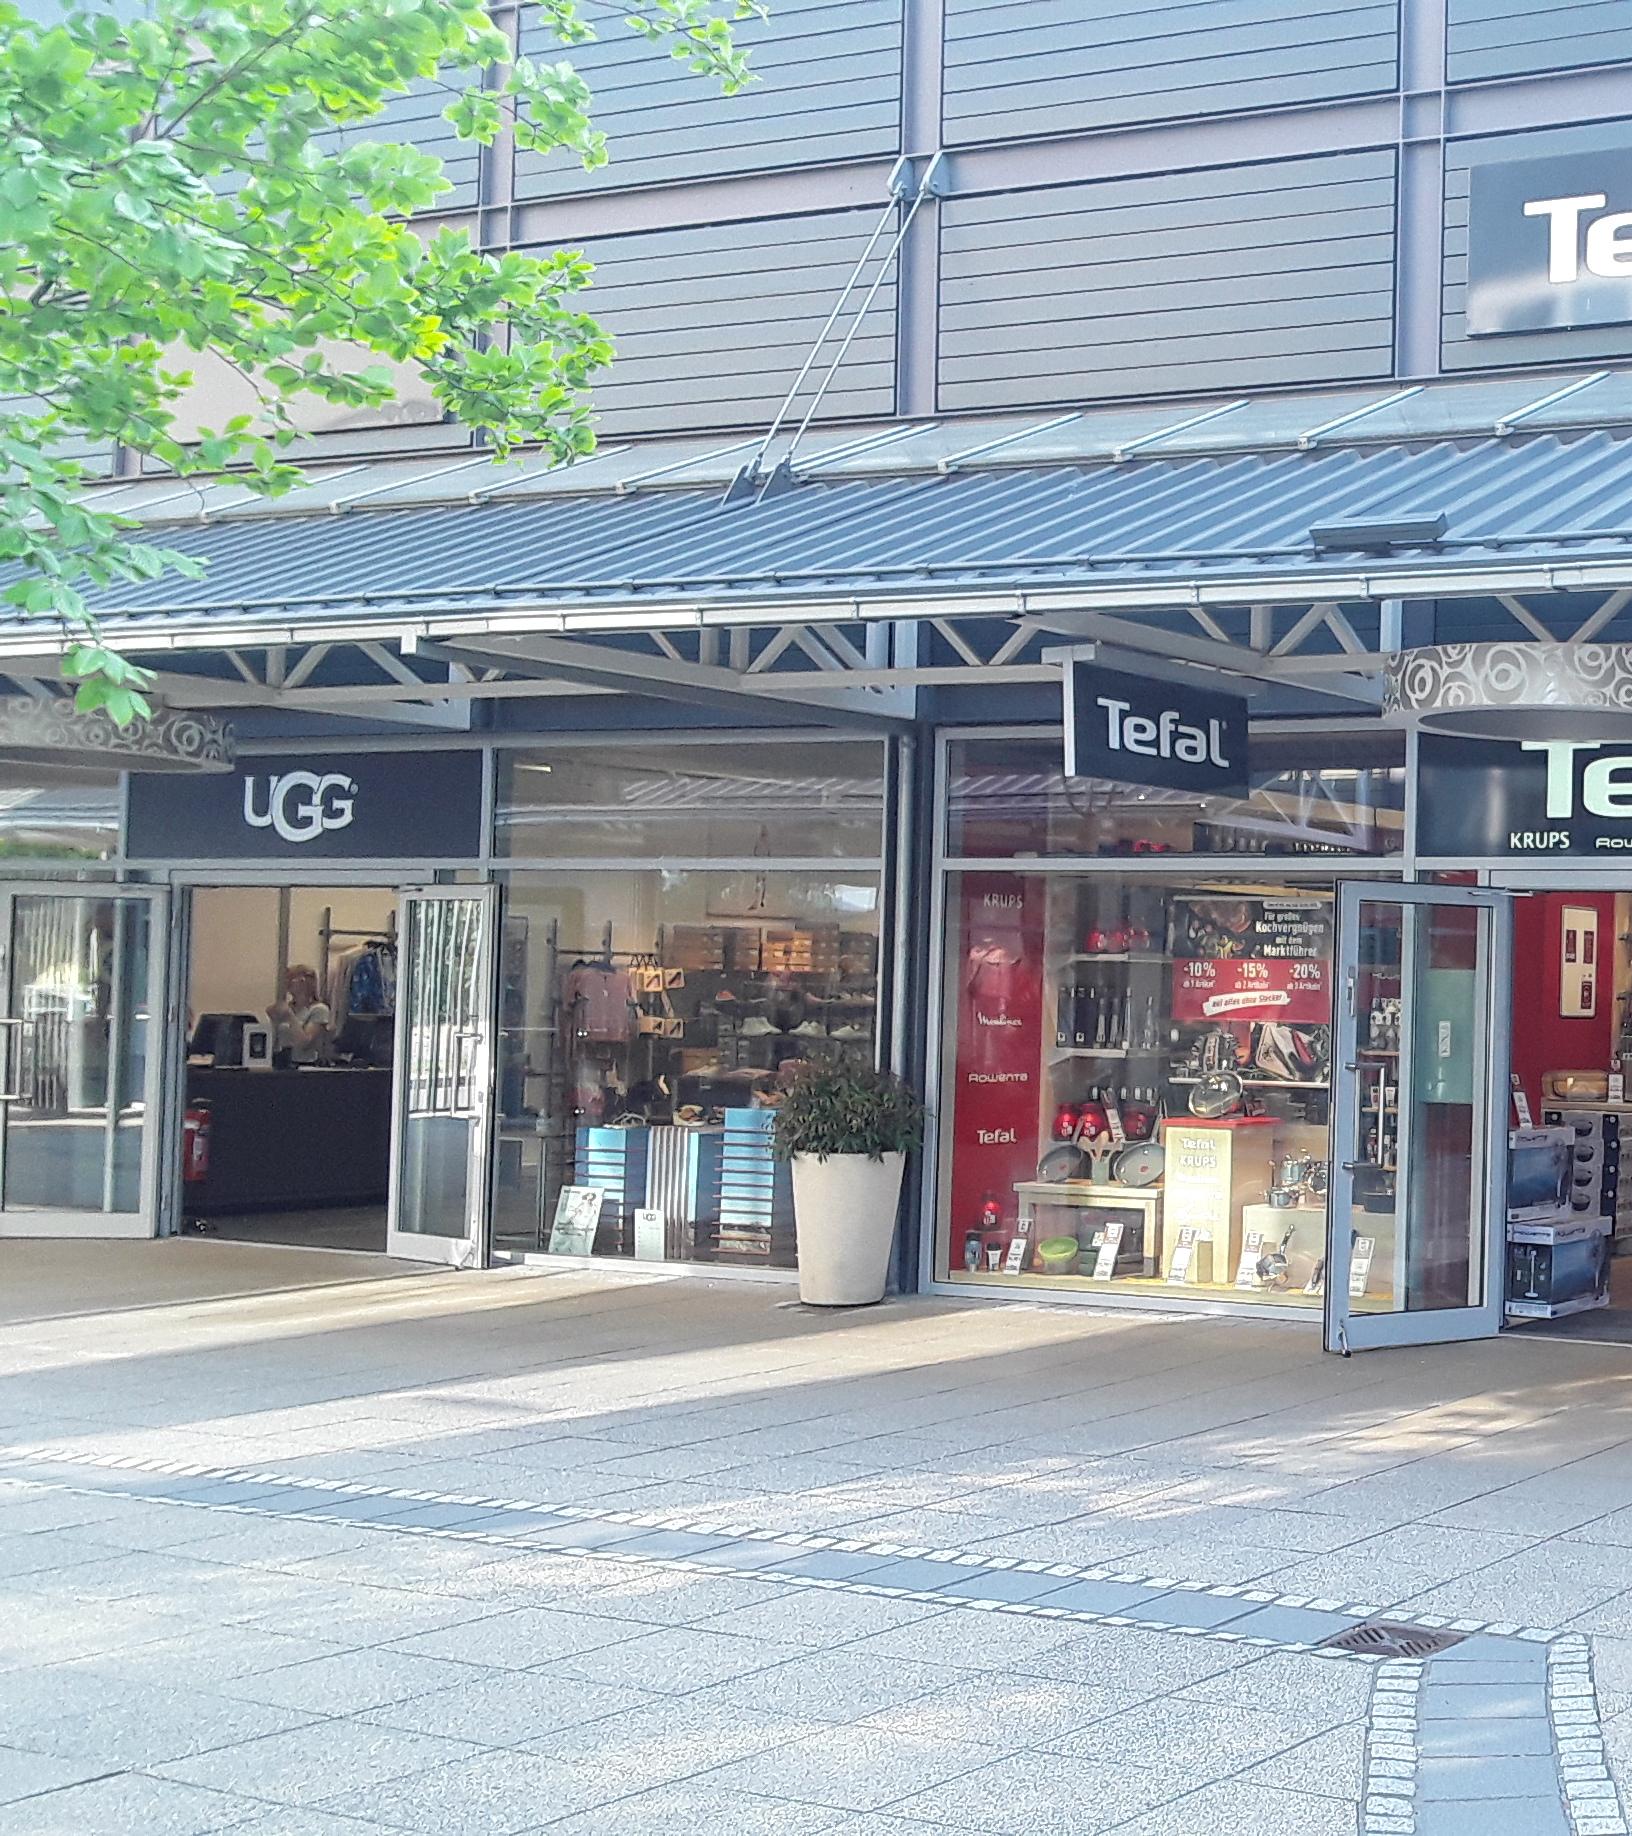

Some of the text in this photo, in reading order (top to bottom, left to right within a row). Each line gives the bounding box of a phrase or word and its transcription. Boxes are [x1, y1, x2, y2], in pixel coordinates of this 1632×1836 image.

[1096, 697, 1230, 768] Tefal
[244, 771, 354, 842] UGG
[1510, 832, 1570, 849] KRUPS
[983, 893, 1023, 909] KRUPS
[1183, 962, 1321, 979] -10% -15% -20%
[977, 1128, 1017, 1145] Tefal
[1179, 1154, 1217, 1169] KRUPS
